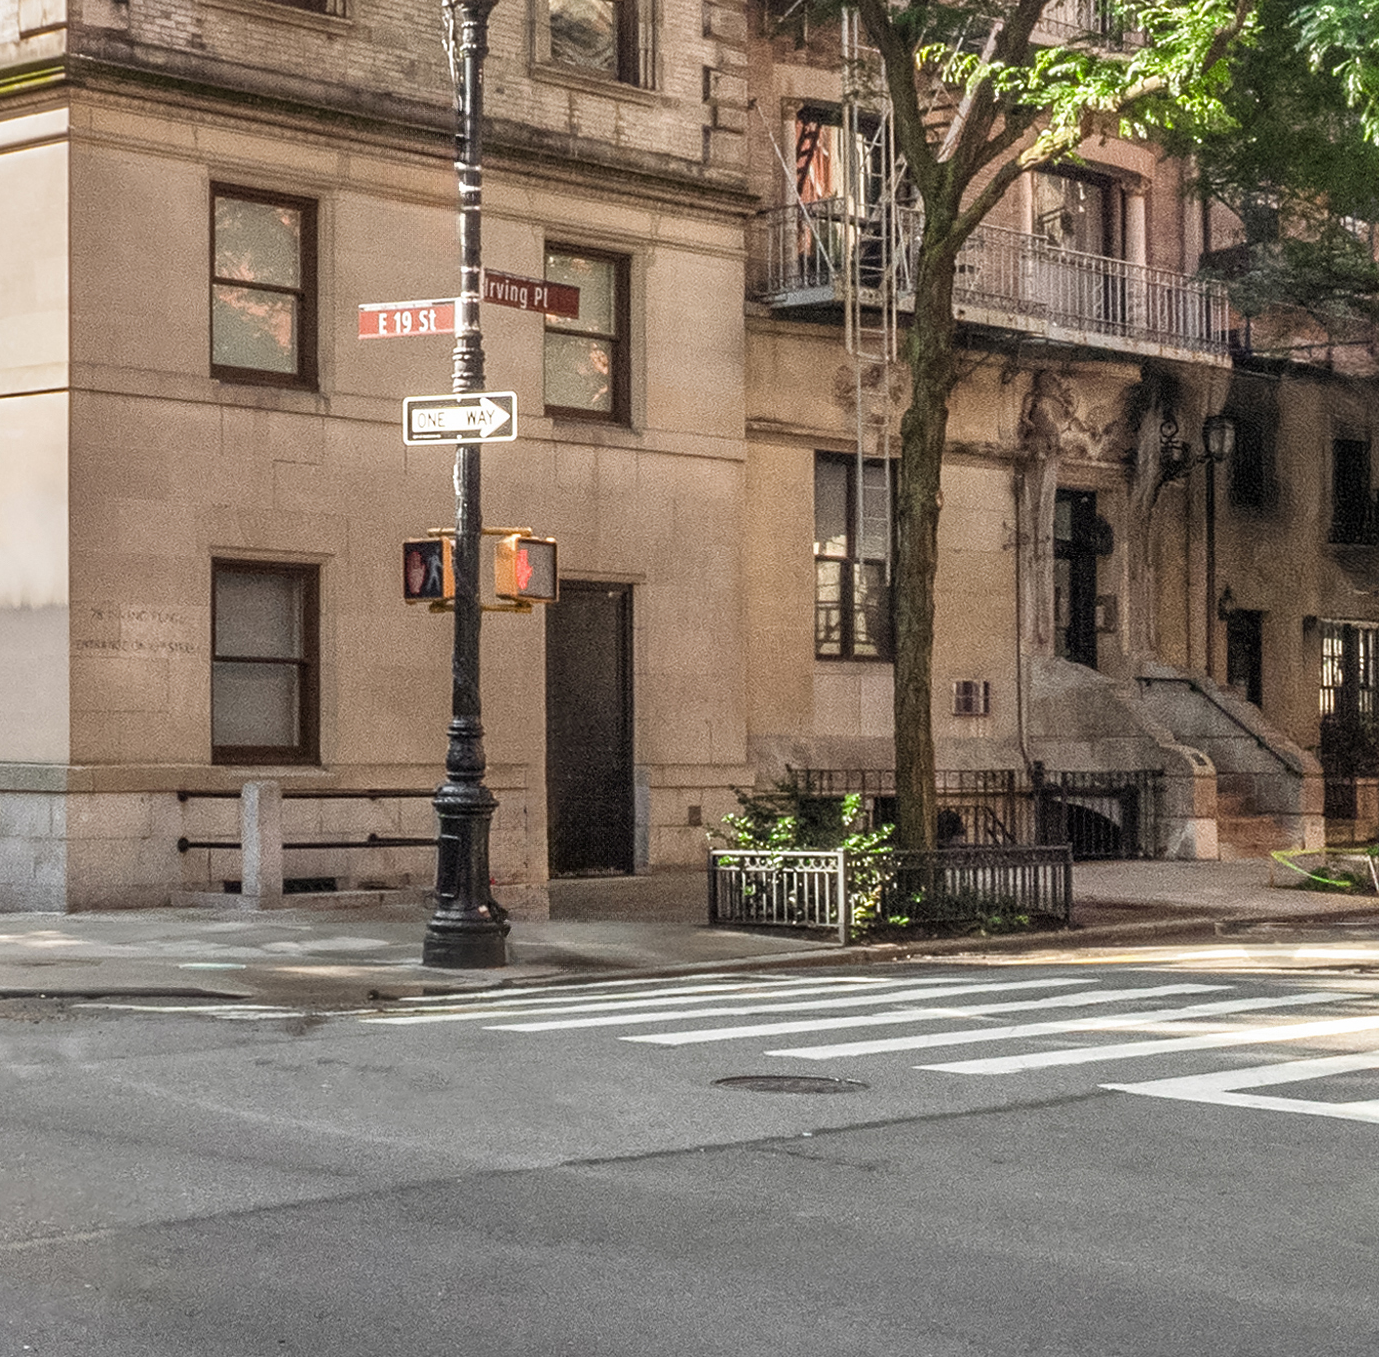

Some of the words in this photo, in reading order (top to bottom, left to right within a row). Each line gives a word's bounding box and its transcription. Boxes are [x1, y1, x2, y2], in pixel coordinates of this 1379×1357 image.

[485, 278, 528, 309] Irving
[534, 287, 548, 308] Pl
[378, 313, 387, 334] E
[394, 311, 412, 334] 19
[419, 309, 436, 332] St
[418, 412, 445, 428] ONE
[466, 409, 495, 425] WAY
